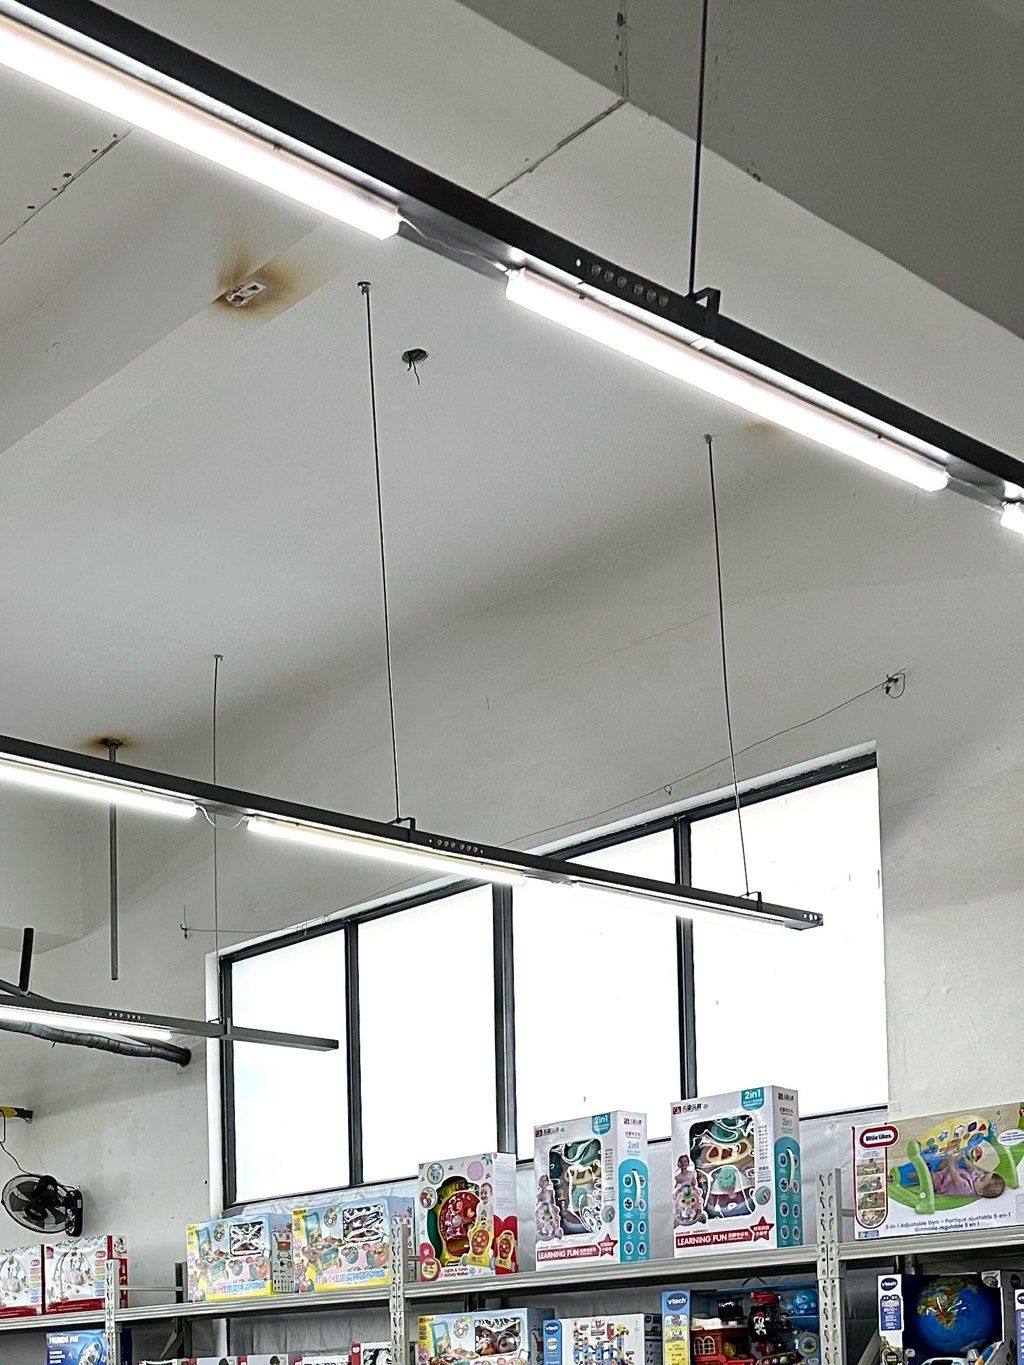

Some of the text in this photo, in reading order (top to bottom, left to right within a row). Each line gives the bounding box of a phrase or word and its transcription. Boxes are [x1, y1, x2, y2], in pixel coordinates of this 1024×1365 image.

[744, 1090, 761, 1100] 2in1
[677, 1235, 711, 1246] LEARNING
[712, 1233, 728, 1242] FUN
[538, 1247, 579, 1260] LEARNING FUN
